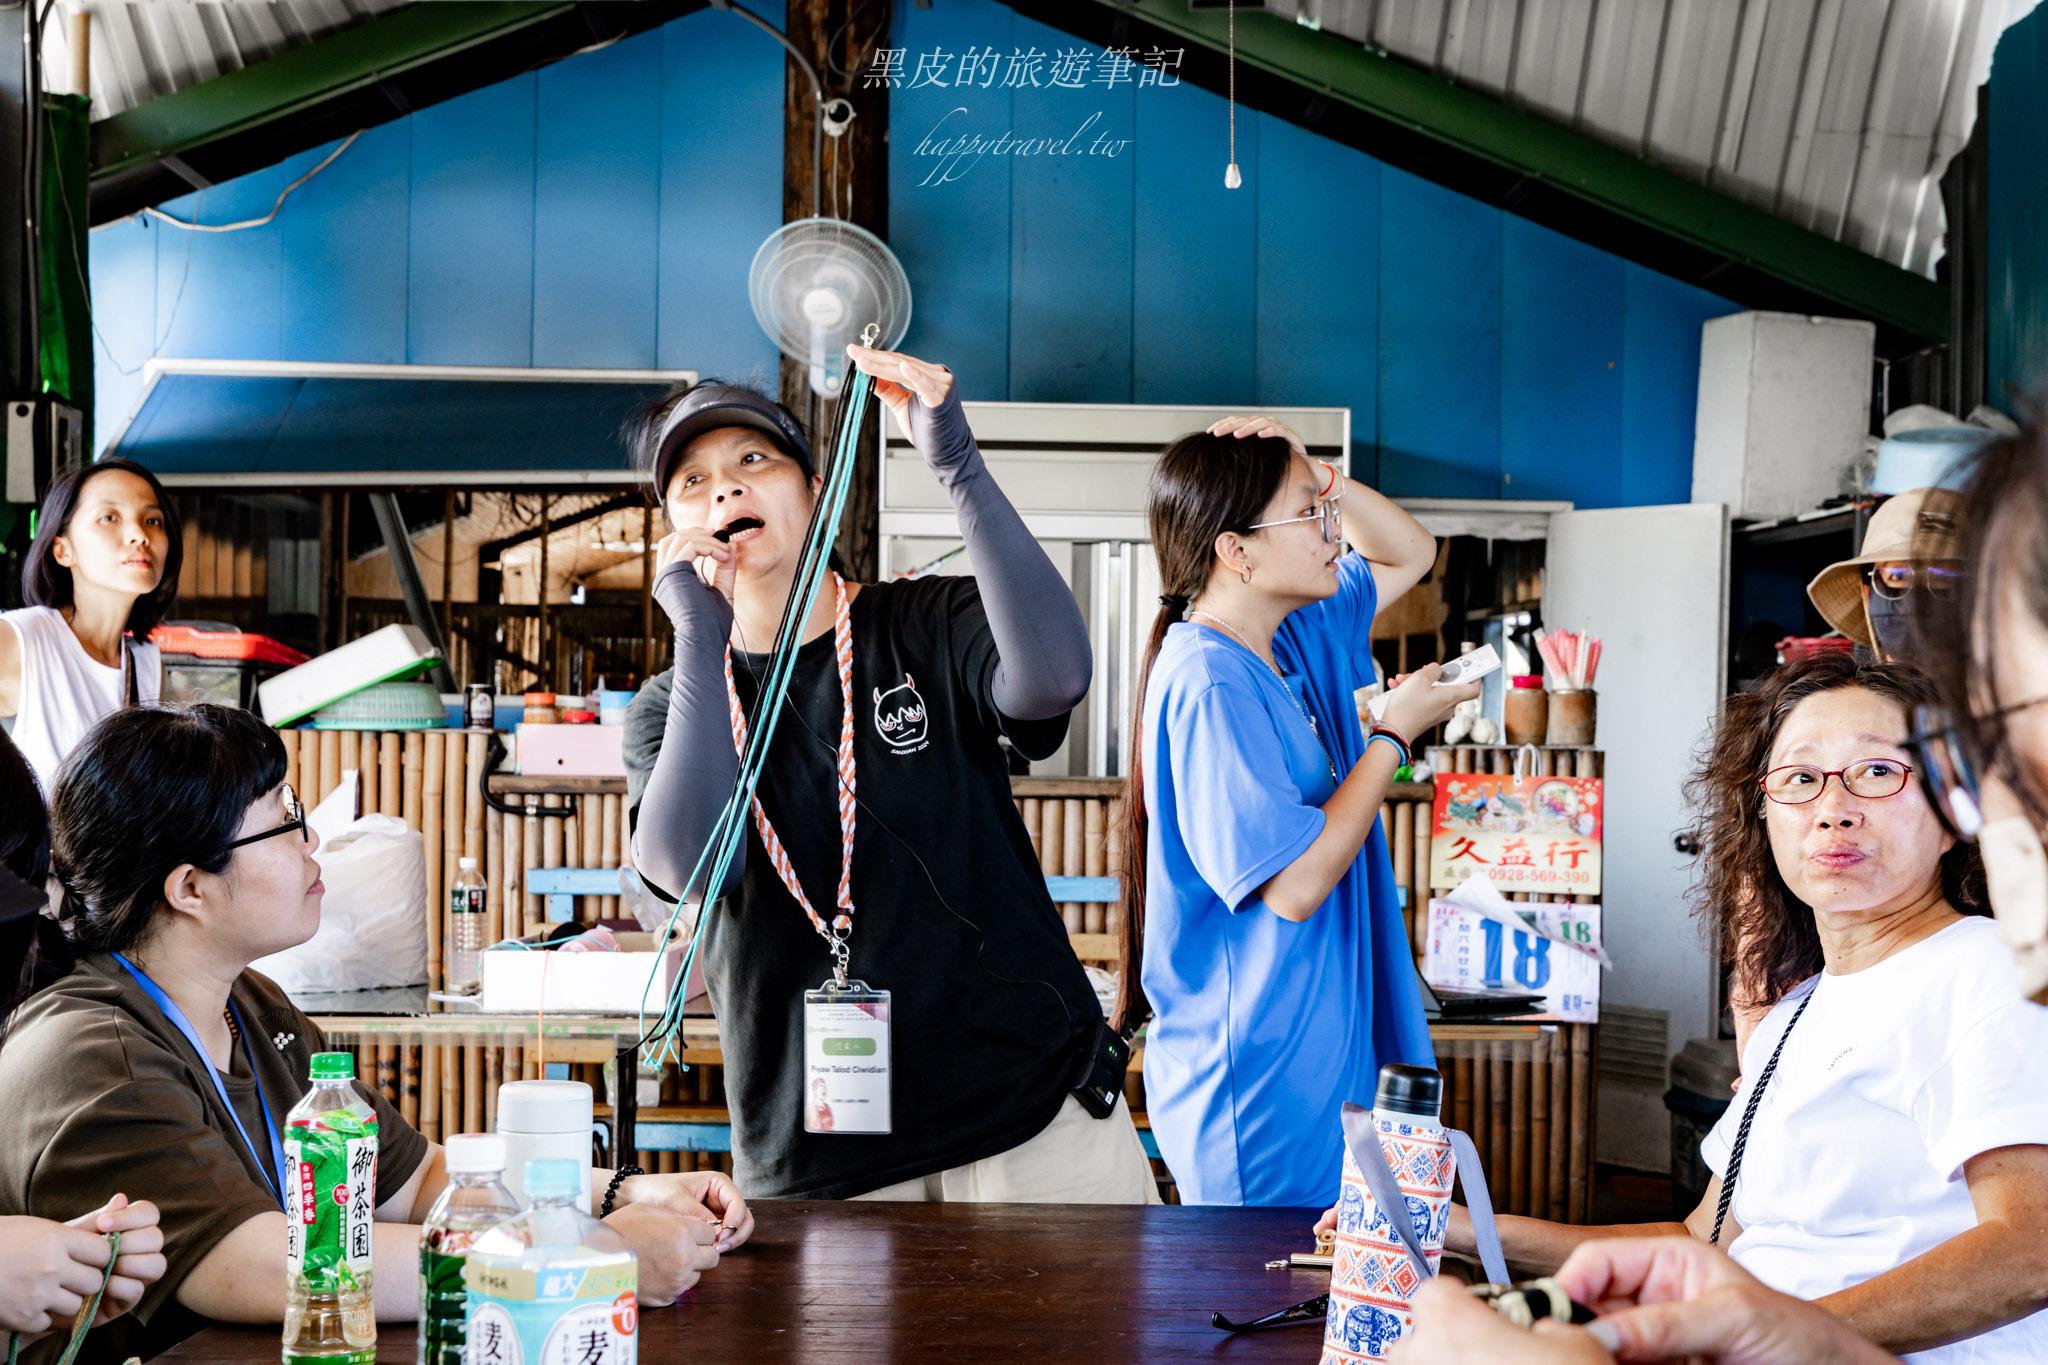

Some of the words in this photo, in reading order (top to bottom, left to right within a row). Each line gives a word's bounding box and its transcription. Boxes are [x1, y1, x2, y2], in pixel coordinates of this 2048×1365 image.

[1446, 836, 1591, 869] 久益行
[1489, 868, 1590, 885] 0928-569-390
[1479, 916, 1551, 990] 18
[352, 1146, 374, 1258] 御茶園
